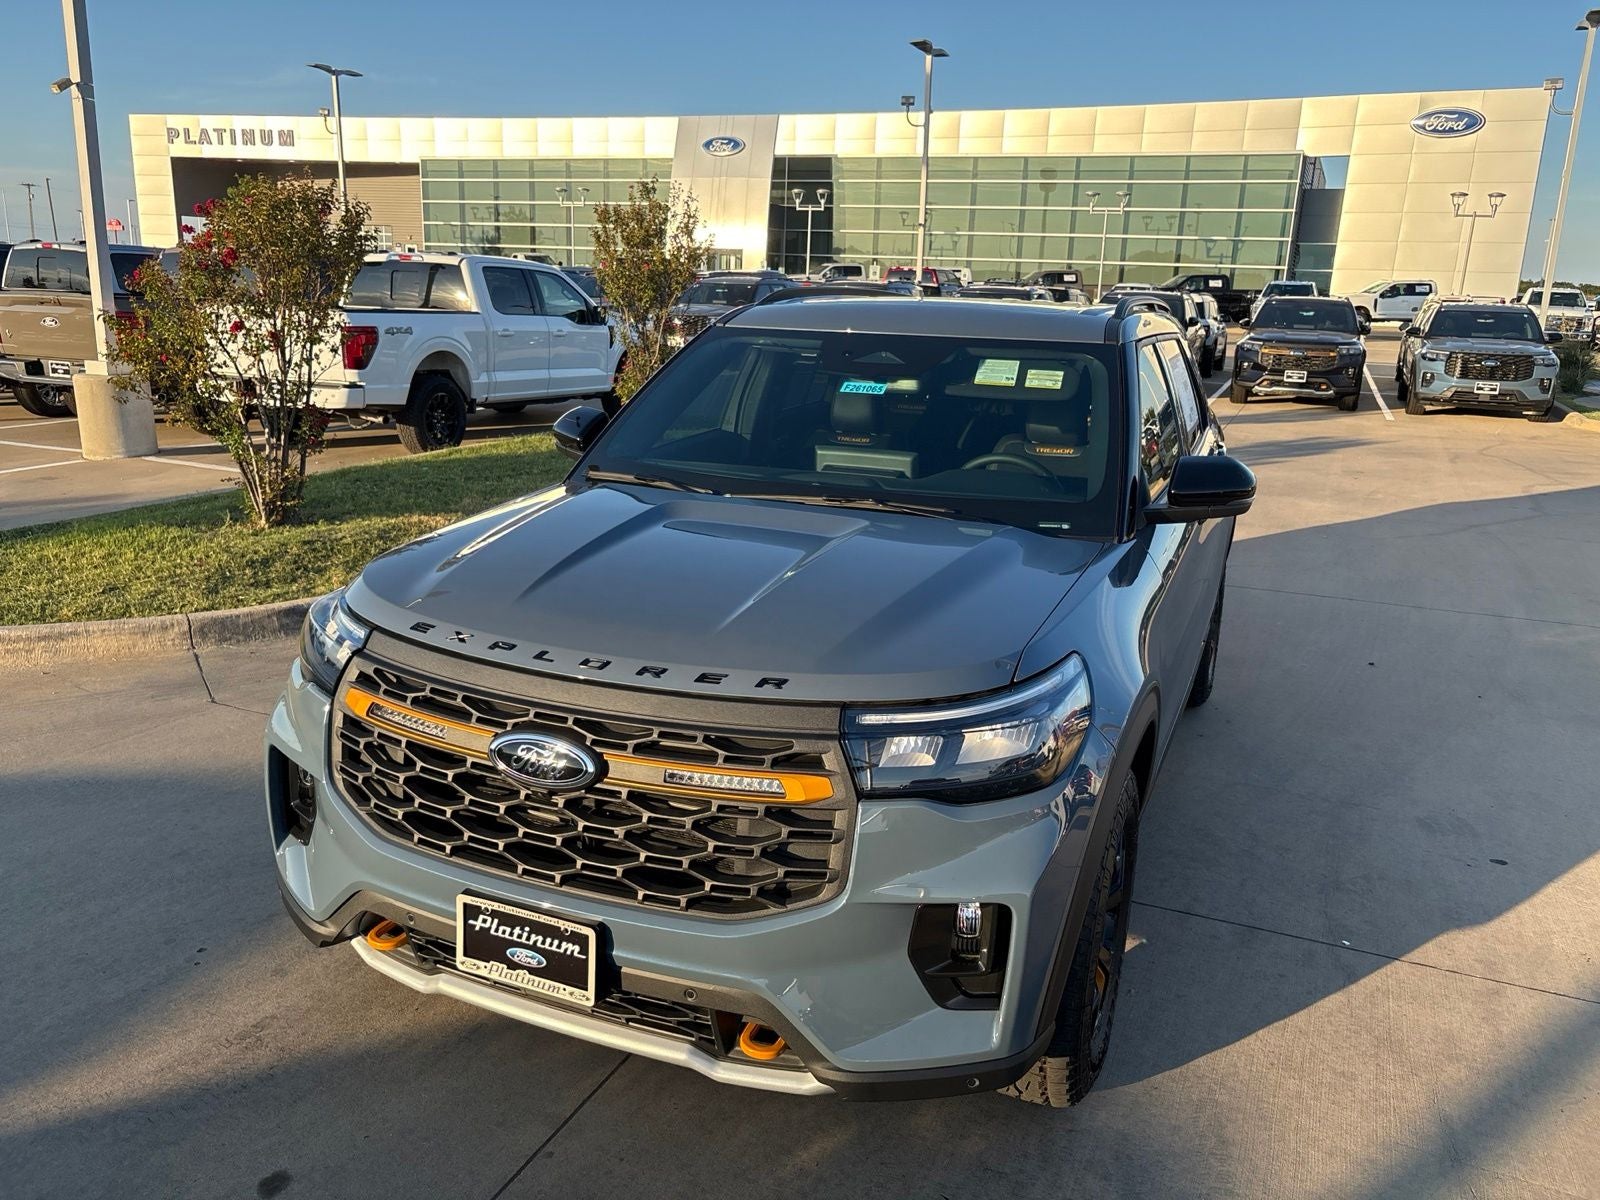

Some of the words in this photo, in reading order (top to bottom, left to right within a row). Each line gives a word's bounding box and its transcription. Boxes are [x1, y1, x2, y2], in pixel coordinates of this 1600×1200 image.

[1425, 113, 1469, 131] Ford
[166, 127, 295, 147] PLATINUM
[709, 139, 735, 152] Ford
[843, 384, 884, 393] F261065
[1035, 447, 1074, 455] TREMOR
[409, 621, 790, 690] EXPLORER
[510, 744, 567, 779] Ford
[467, 914, 587, 959] Platinum
[513, 950, 539, 966] Ford
[487, 962, 562, 995] Platinum
